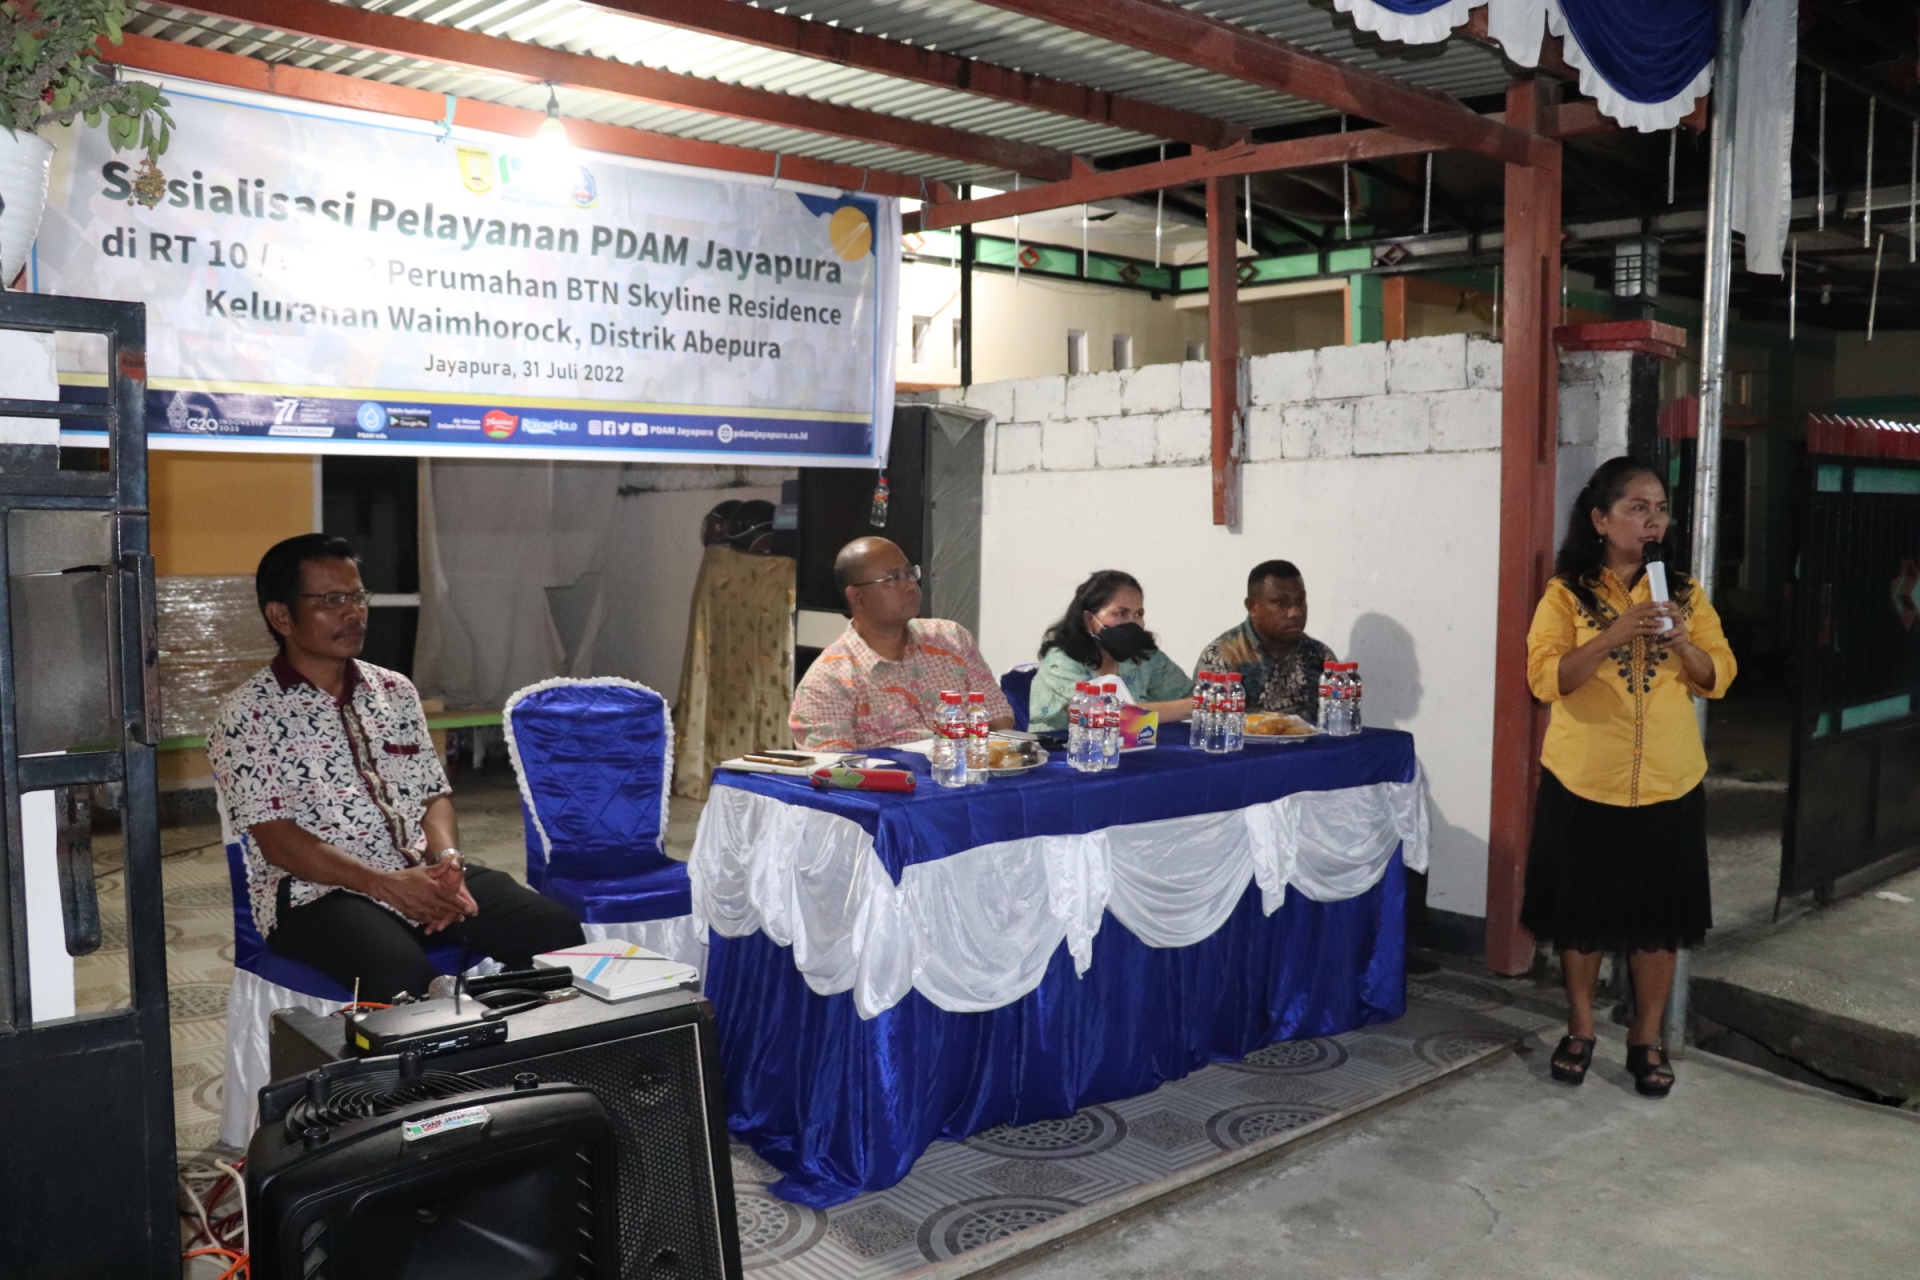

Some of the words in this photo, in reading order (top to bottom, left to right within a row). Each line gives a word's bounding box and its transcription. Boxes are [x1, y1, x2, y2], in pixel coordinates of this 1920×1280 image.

[101, 160, 356, 228] Ssialisasi
[368, 197, 579, 253] Pelayanan
[590, 225, 689, 266] PDAM
[697, 240, 842, 285] Jayapura
[101, 227, 137, 259] di
[149, 232, 197, 264] RT
[207, 239, 249, 269] 10
[388, 259, 557, 299] Perumahan
[566, 277, 620, 305] BTN
[627, 283, 721, 316] Skyline
[728, 293, 842, 326] Residence
[388, 305, 581, 351] Waimhorock,
[590, 322, 676, 352] Distrik
[683, 330, 781, 362] Abepura
[424, 354, 517, 378] Jayapura,
[523, 360, 539, 378] 31
[547, 361, 579, 380] Juli
[584, 364, 624, 383] 2022
[186, 417, 219, 431] G20
[650, 425, 676, 436] PDAM
[677, 426, 714, 438] Jayapura
